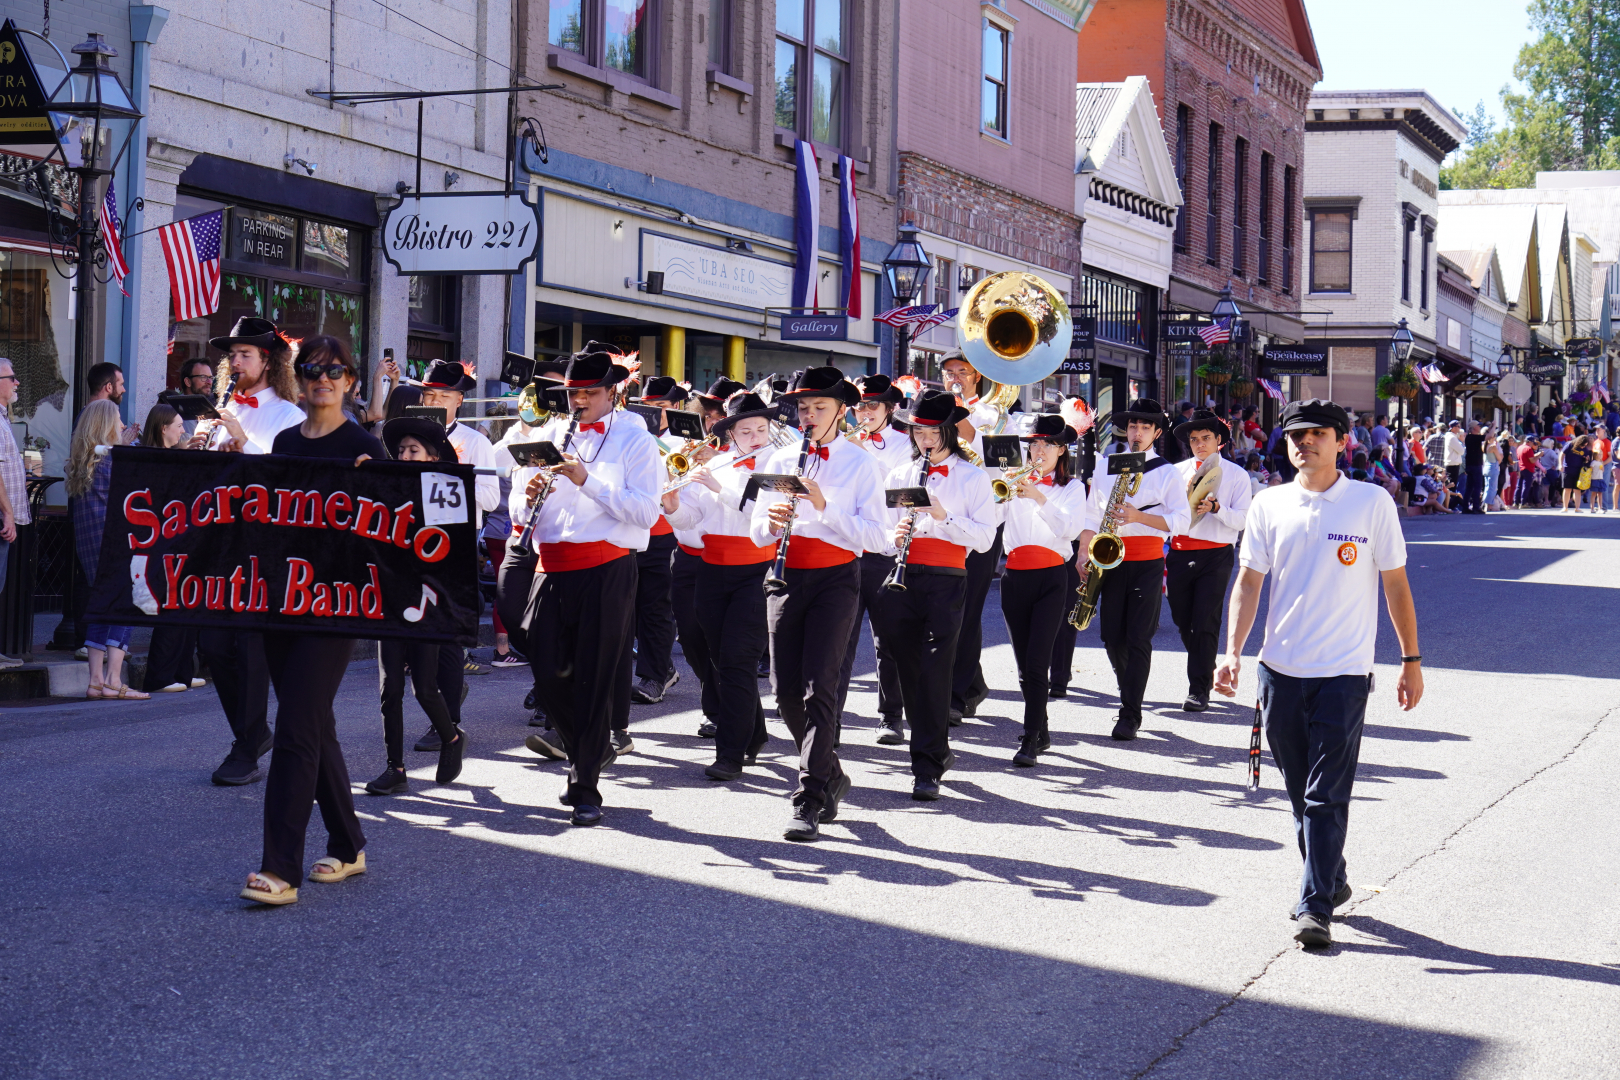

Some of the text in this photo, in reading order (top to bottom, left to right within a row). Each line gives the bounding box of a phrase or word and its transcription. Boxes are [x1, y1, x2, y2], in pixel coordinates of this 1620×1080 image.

[0, 75, 26, 88] TRA
[0, 94, 27, 107] OVA
[243, 218, 286, 240] PARKING
[393, 213, 531, 250] Bistro 221
[243, 238, 284, 259] IN REAR
[733, 266, 755, 285] SEO
[791, 320, 838, 336] Gallery
[1265, 350, 1326, 362] Speakeasy
[1060, 362, 1091, 371] PASS
[428, 481, 461, 509] 43
[123, 483, 450, 563] Sacramento
[1327, 533, 1368, 543] DIRECTOR
[162, 553, 385, 619] Youth Band
